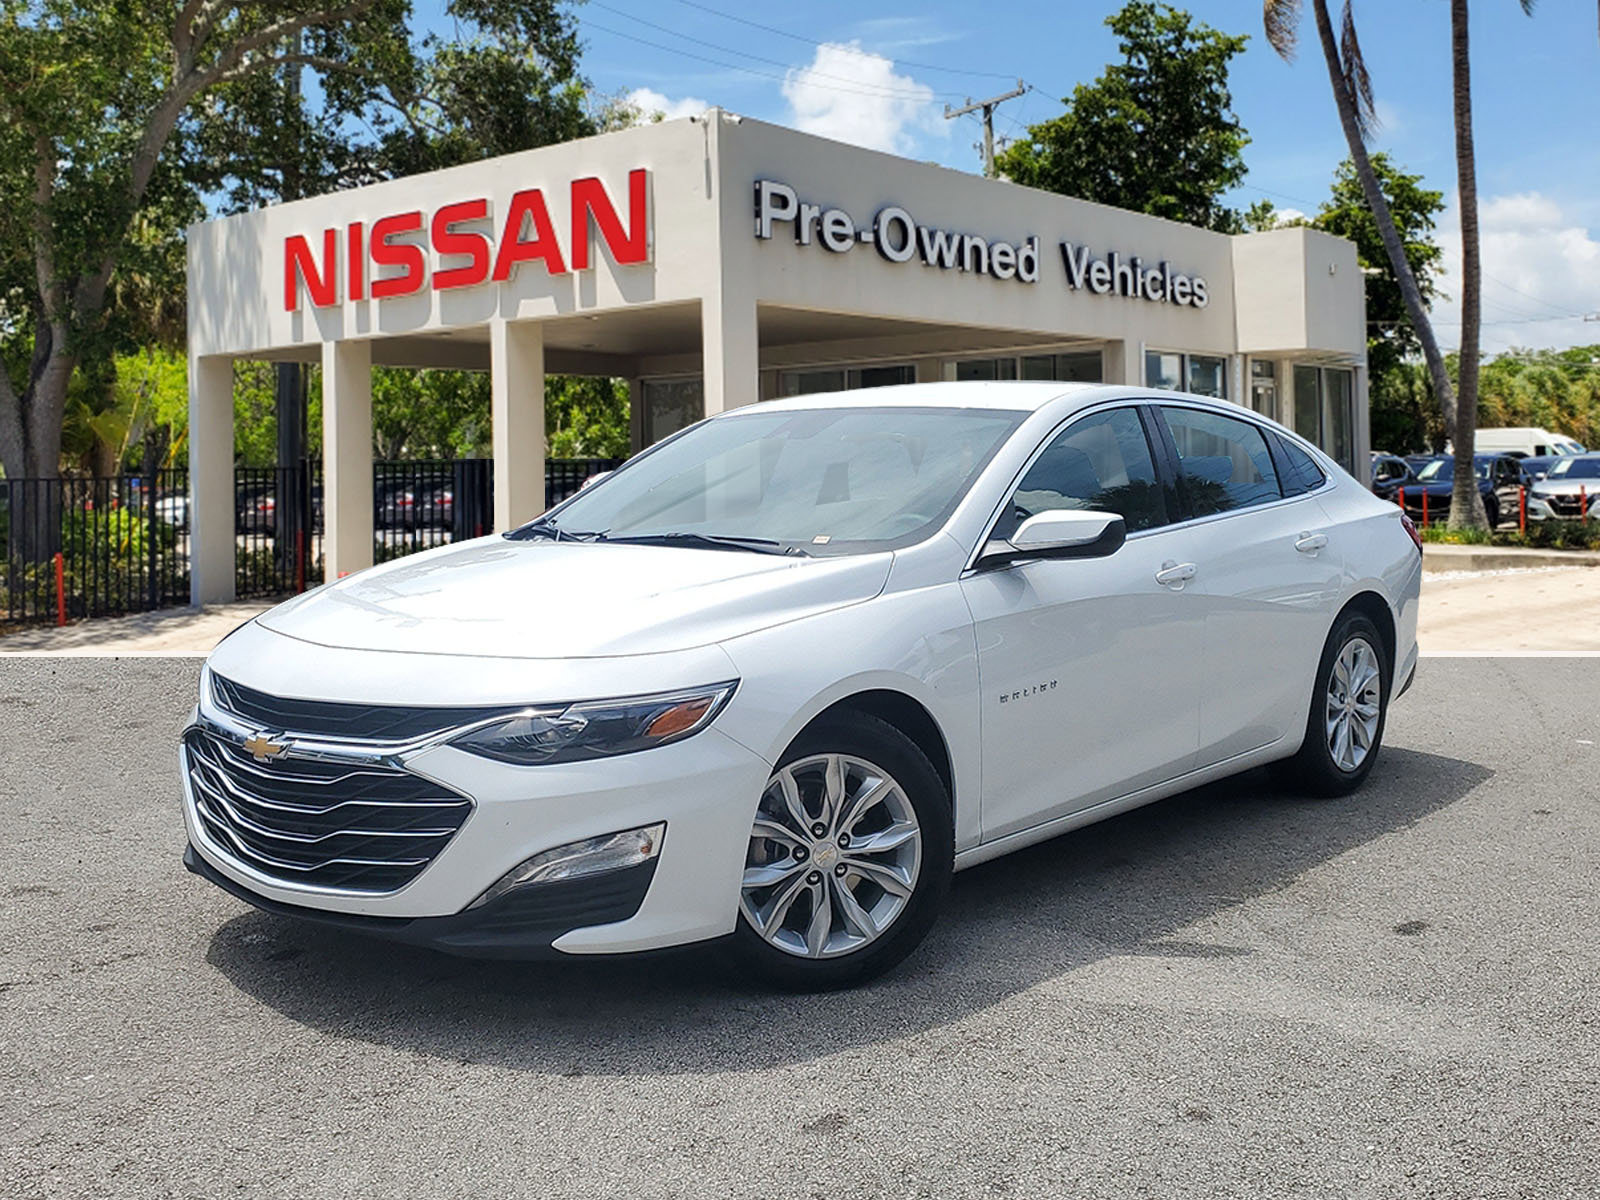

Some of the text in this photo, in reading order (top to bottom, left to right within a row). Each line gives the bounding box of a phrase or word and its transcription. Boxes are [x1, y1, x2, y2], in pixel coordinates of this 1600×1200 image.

[284, 168, 648, 312] NISSAN
[754, 179, 1209, 308] Pre-Owned Vehicles
